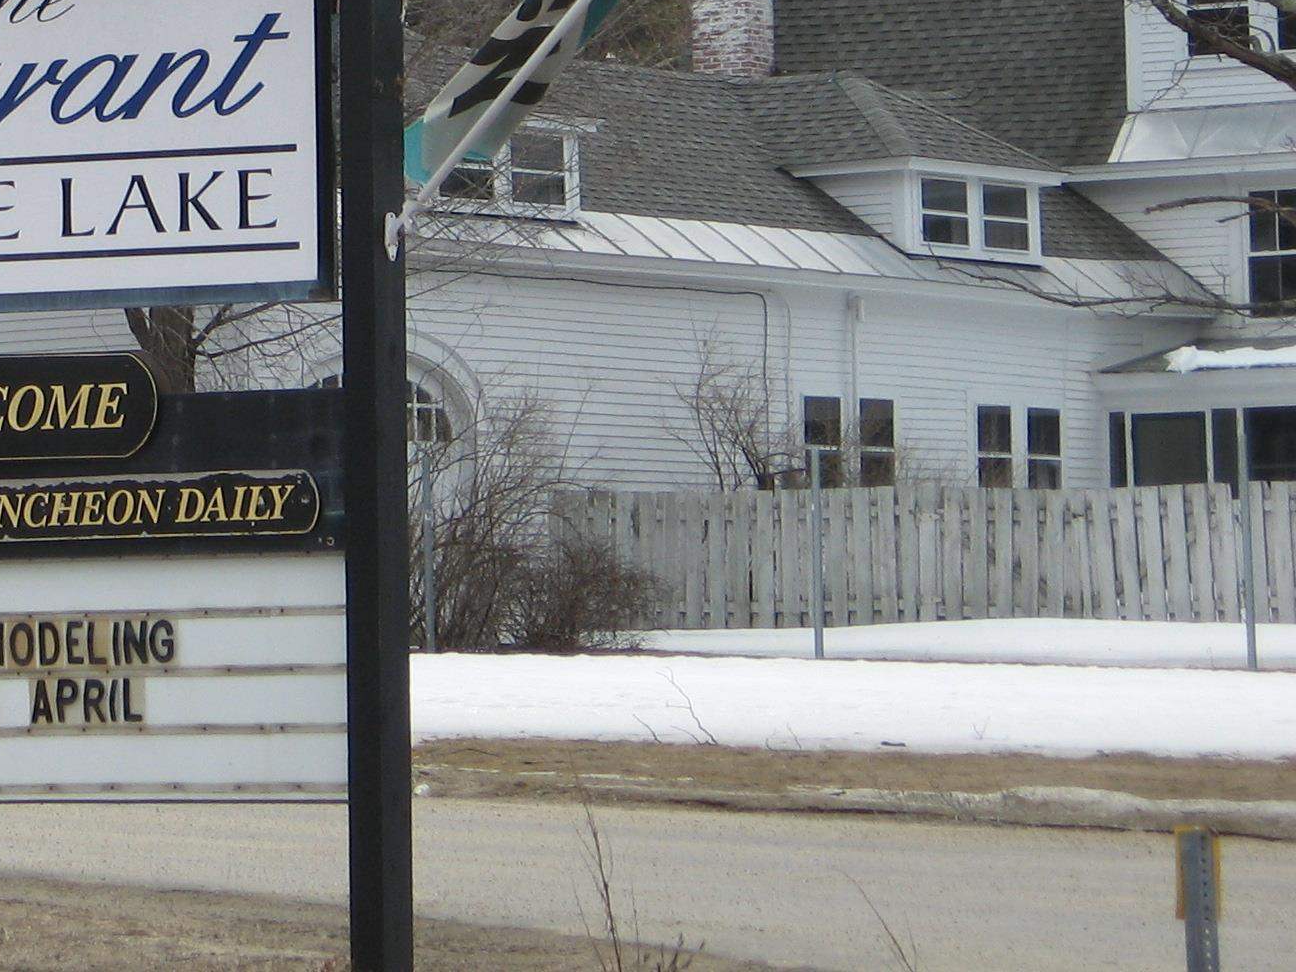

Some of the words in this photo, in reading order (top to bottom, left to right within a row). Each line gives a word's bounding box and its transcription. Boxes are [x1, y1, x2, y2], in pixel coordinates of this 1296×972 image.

[61, 169, 278, 238] LAKE
[173, 484, 295, 523] DAILY
[31, 677, 143, 725] APRIL
